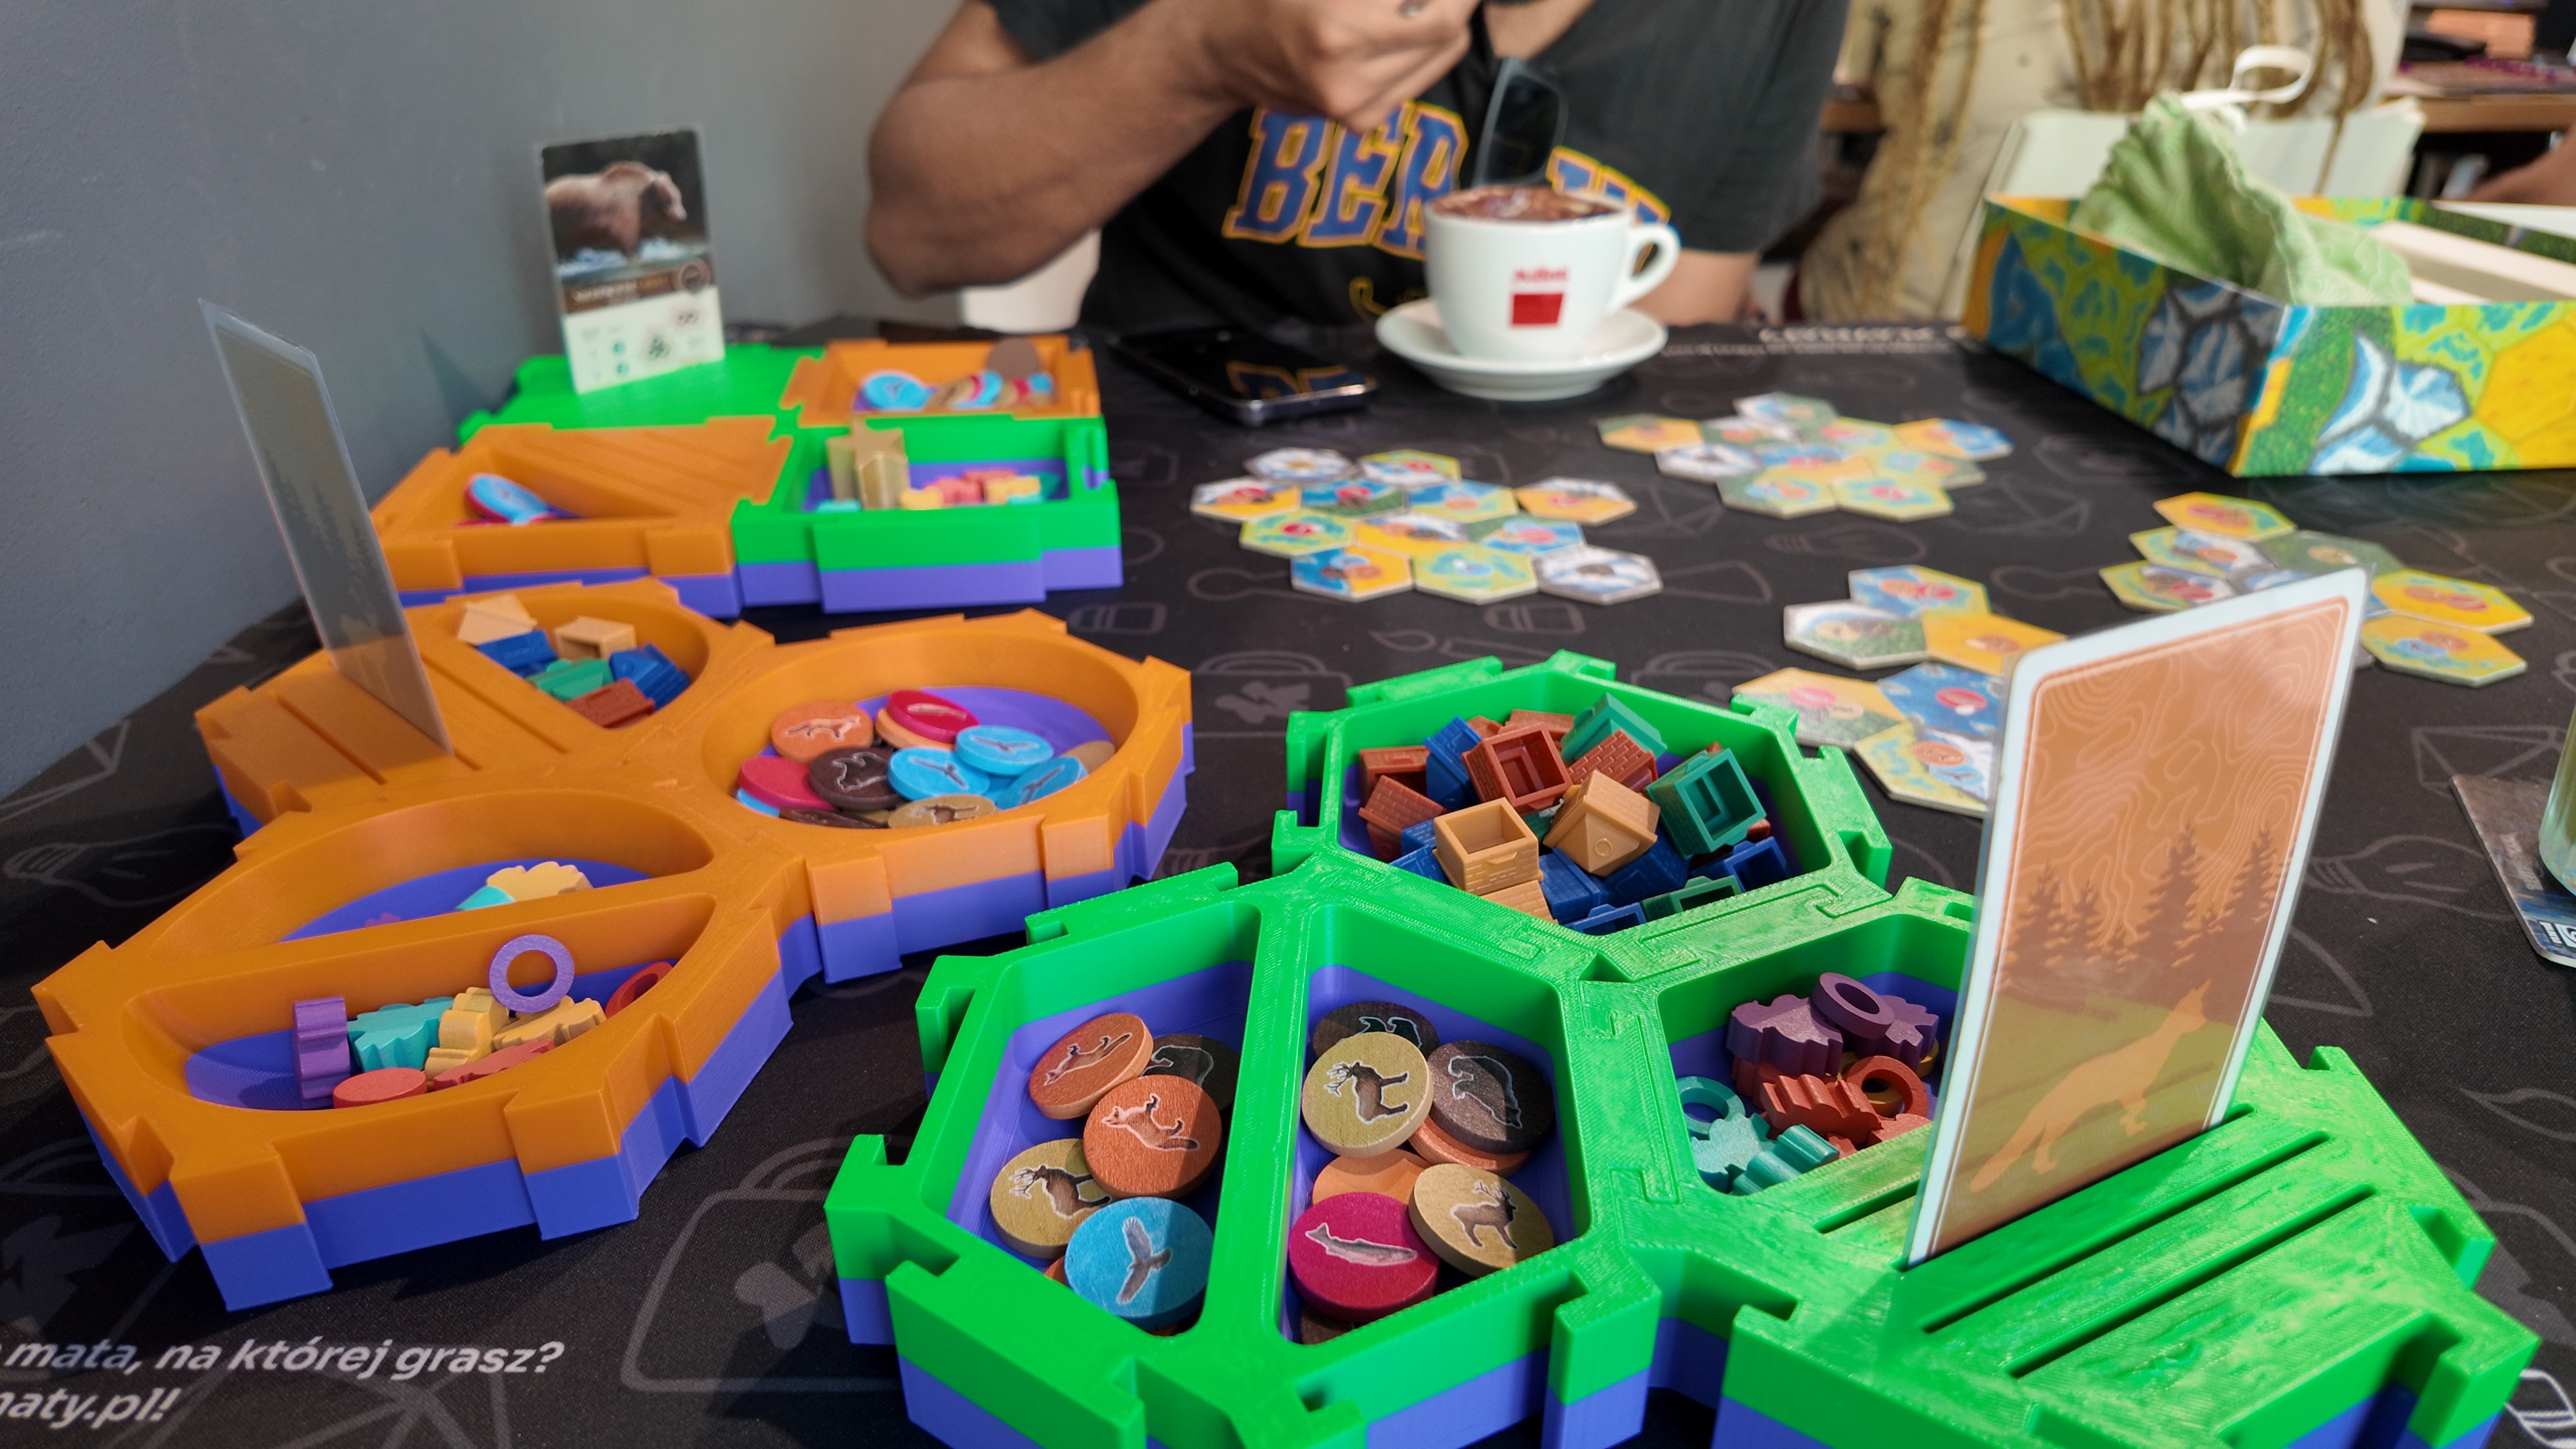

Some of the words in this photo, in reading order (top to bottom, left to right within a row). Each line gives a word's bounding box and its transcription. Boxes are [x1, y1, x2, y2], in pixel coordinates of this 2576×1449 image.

[1222, 100, 1470, 261] BER
[4, 1339, 142, 1375] mata,
[155, 1344, 222, 1370] na
[227, 1336, 393, 1380] której
[390, 1341, 565, 1381] grasz?
